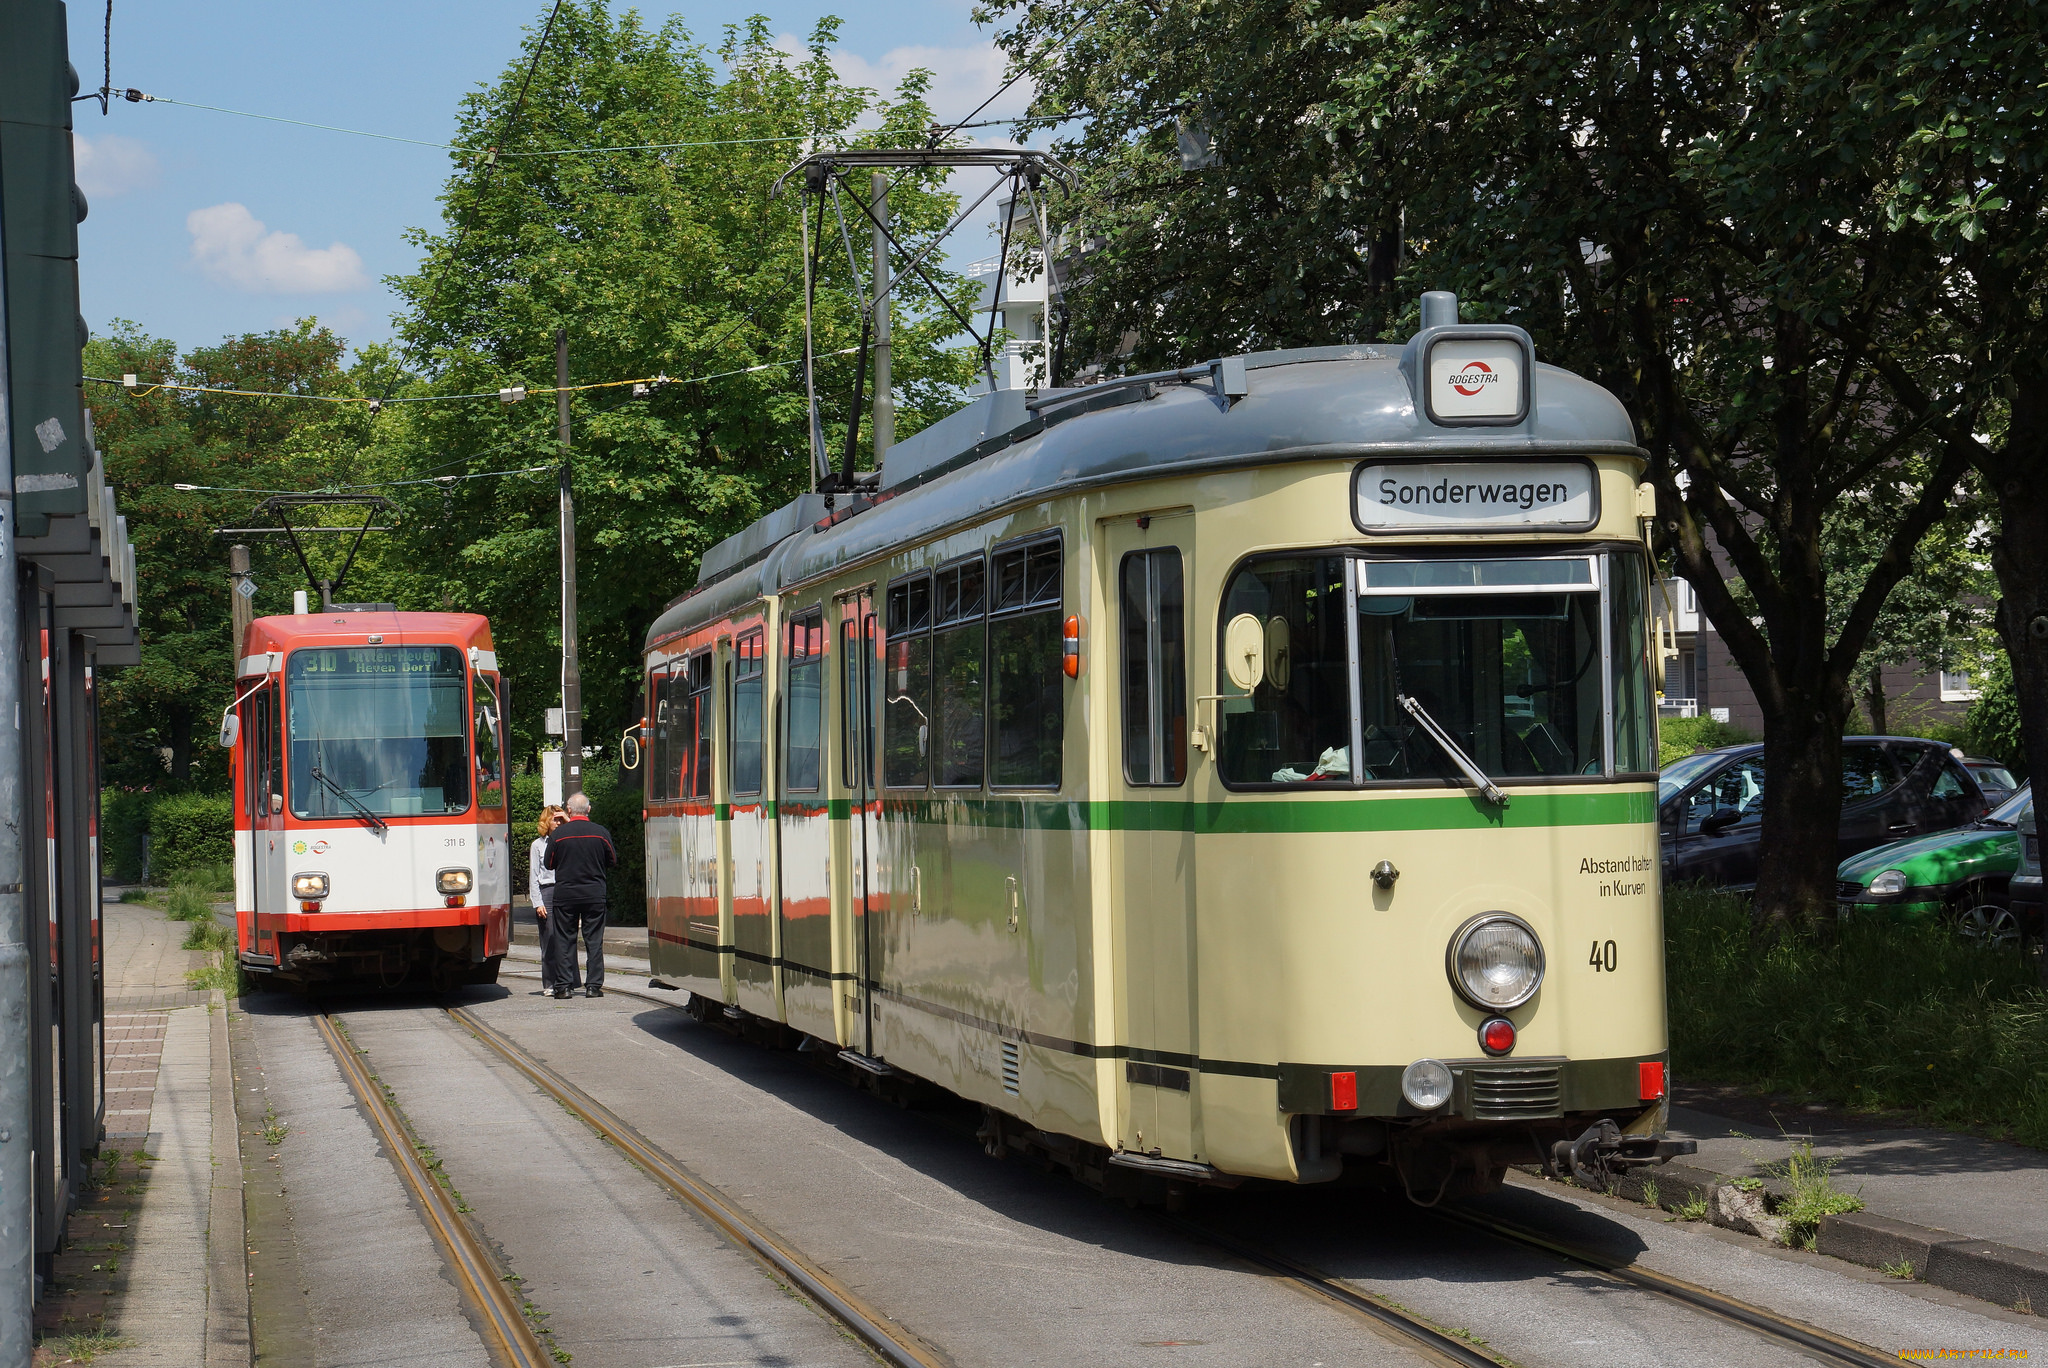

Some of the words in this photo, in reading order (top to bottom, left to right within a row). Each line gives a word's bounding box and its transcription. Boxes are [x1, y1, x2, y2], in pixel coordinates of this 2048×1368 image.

[1448, 373, 1498, 385] BOGESTRA
[1379, 478, 1568, 510] Sonderwagen
[306, 652, 337, 672] 310
[356, 663, 396, 673] Heven
[444, 838, 456, 847] 311
[459, 838, 466, 847] B
[1579, 856, 1631, 874] Abstand
[1632, 855, 1653, 872] halten
[1600, 880, 1611, 897] in
[1613, 880, 1646, 897] Kurven
[1589, 940, 1618, 972] 40
